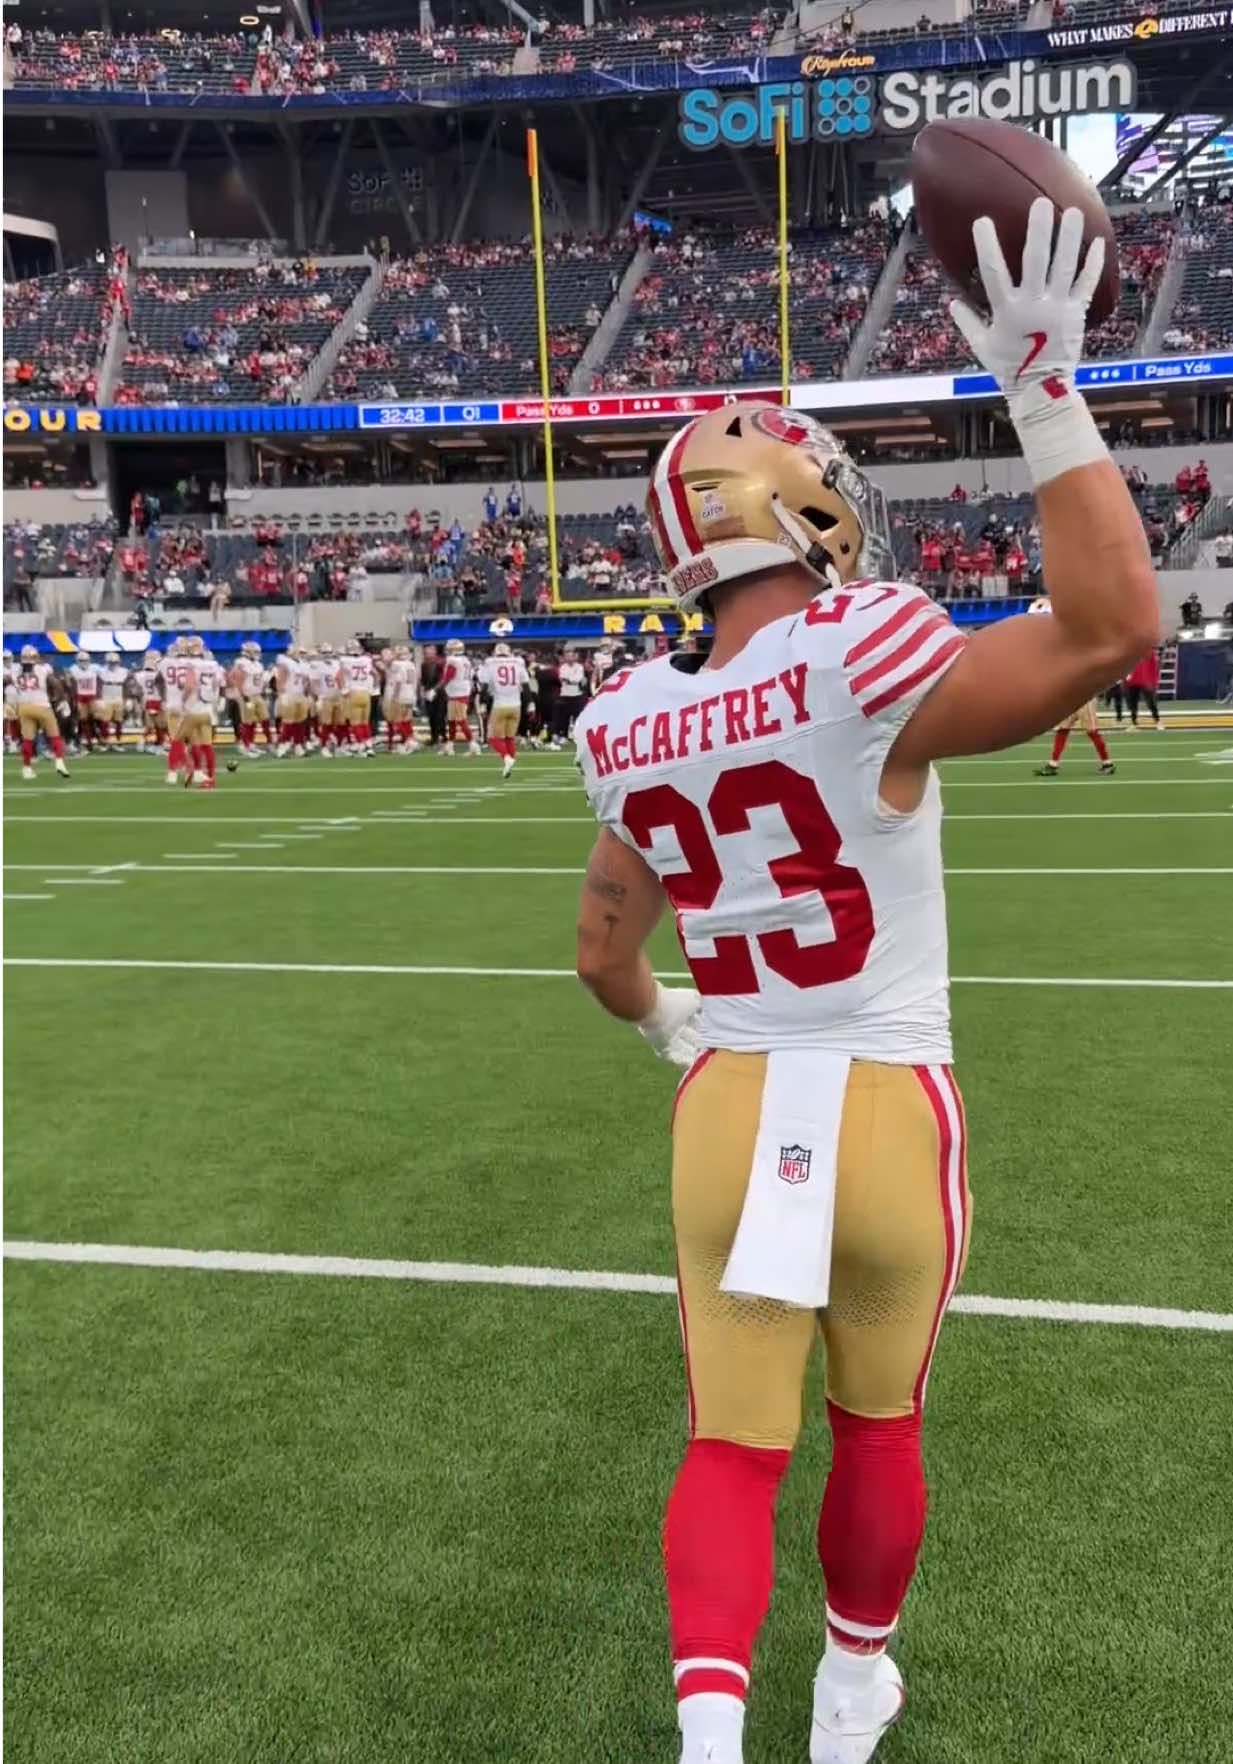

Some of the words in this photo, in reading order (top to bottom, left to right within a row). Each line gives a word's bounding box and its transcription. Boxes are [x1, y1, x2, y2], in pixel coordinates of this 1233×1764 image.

[1047, 30, 1088, 47] WHAT
[1089, 23, 1133, 43] MAKES
[1159, 11, 1228, 34] DIFFERENT
[683, 84, 804, 145] SoFi
[884, 62, 1132, 130] Stadium
[347, 170, 394, 195] SoF
[1145, 365, 1182, 377] Pass
[1183, 361, 1212, 374] Yds
[4, 409, 102, 432] OUR
[380, 408, 425, 424] 32:42
[603, 612, 704, 634] RAM
[497, 665, 517, 686] 91
[586, 663, 810, 778] McCAFFREY
[621, 759, 876, 996] 23
[781, 1160, 807, 1179] NFL
